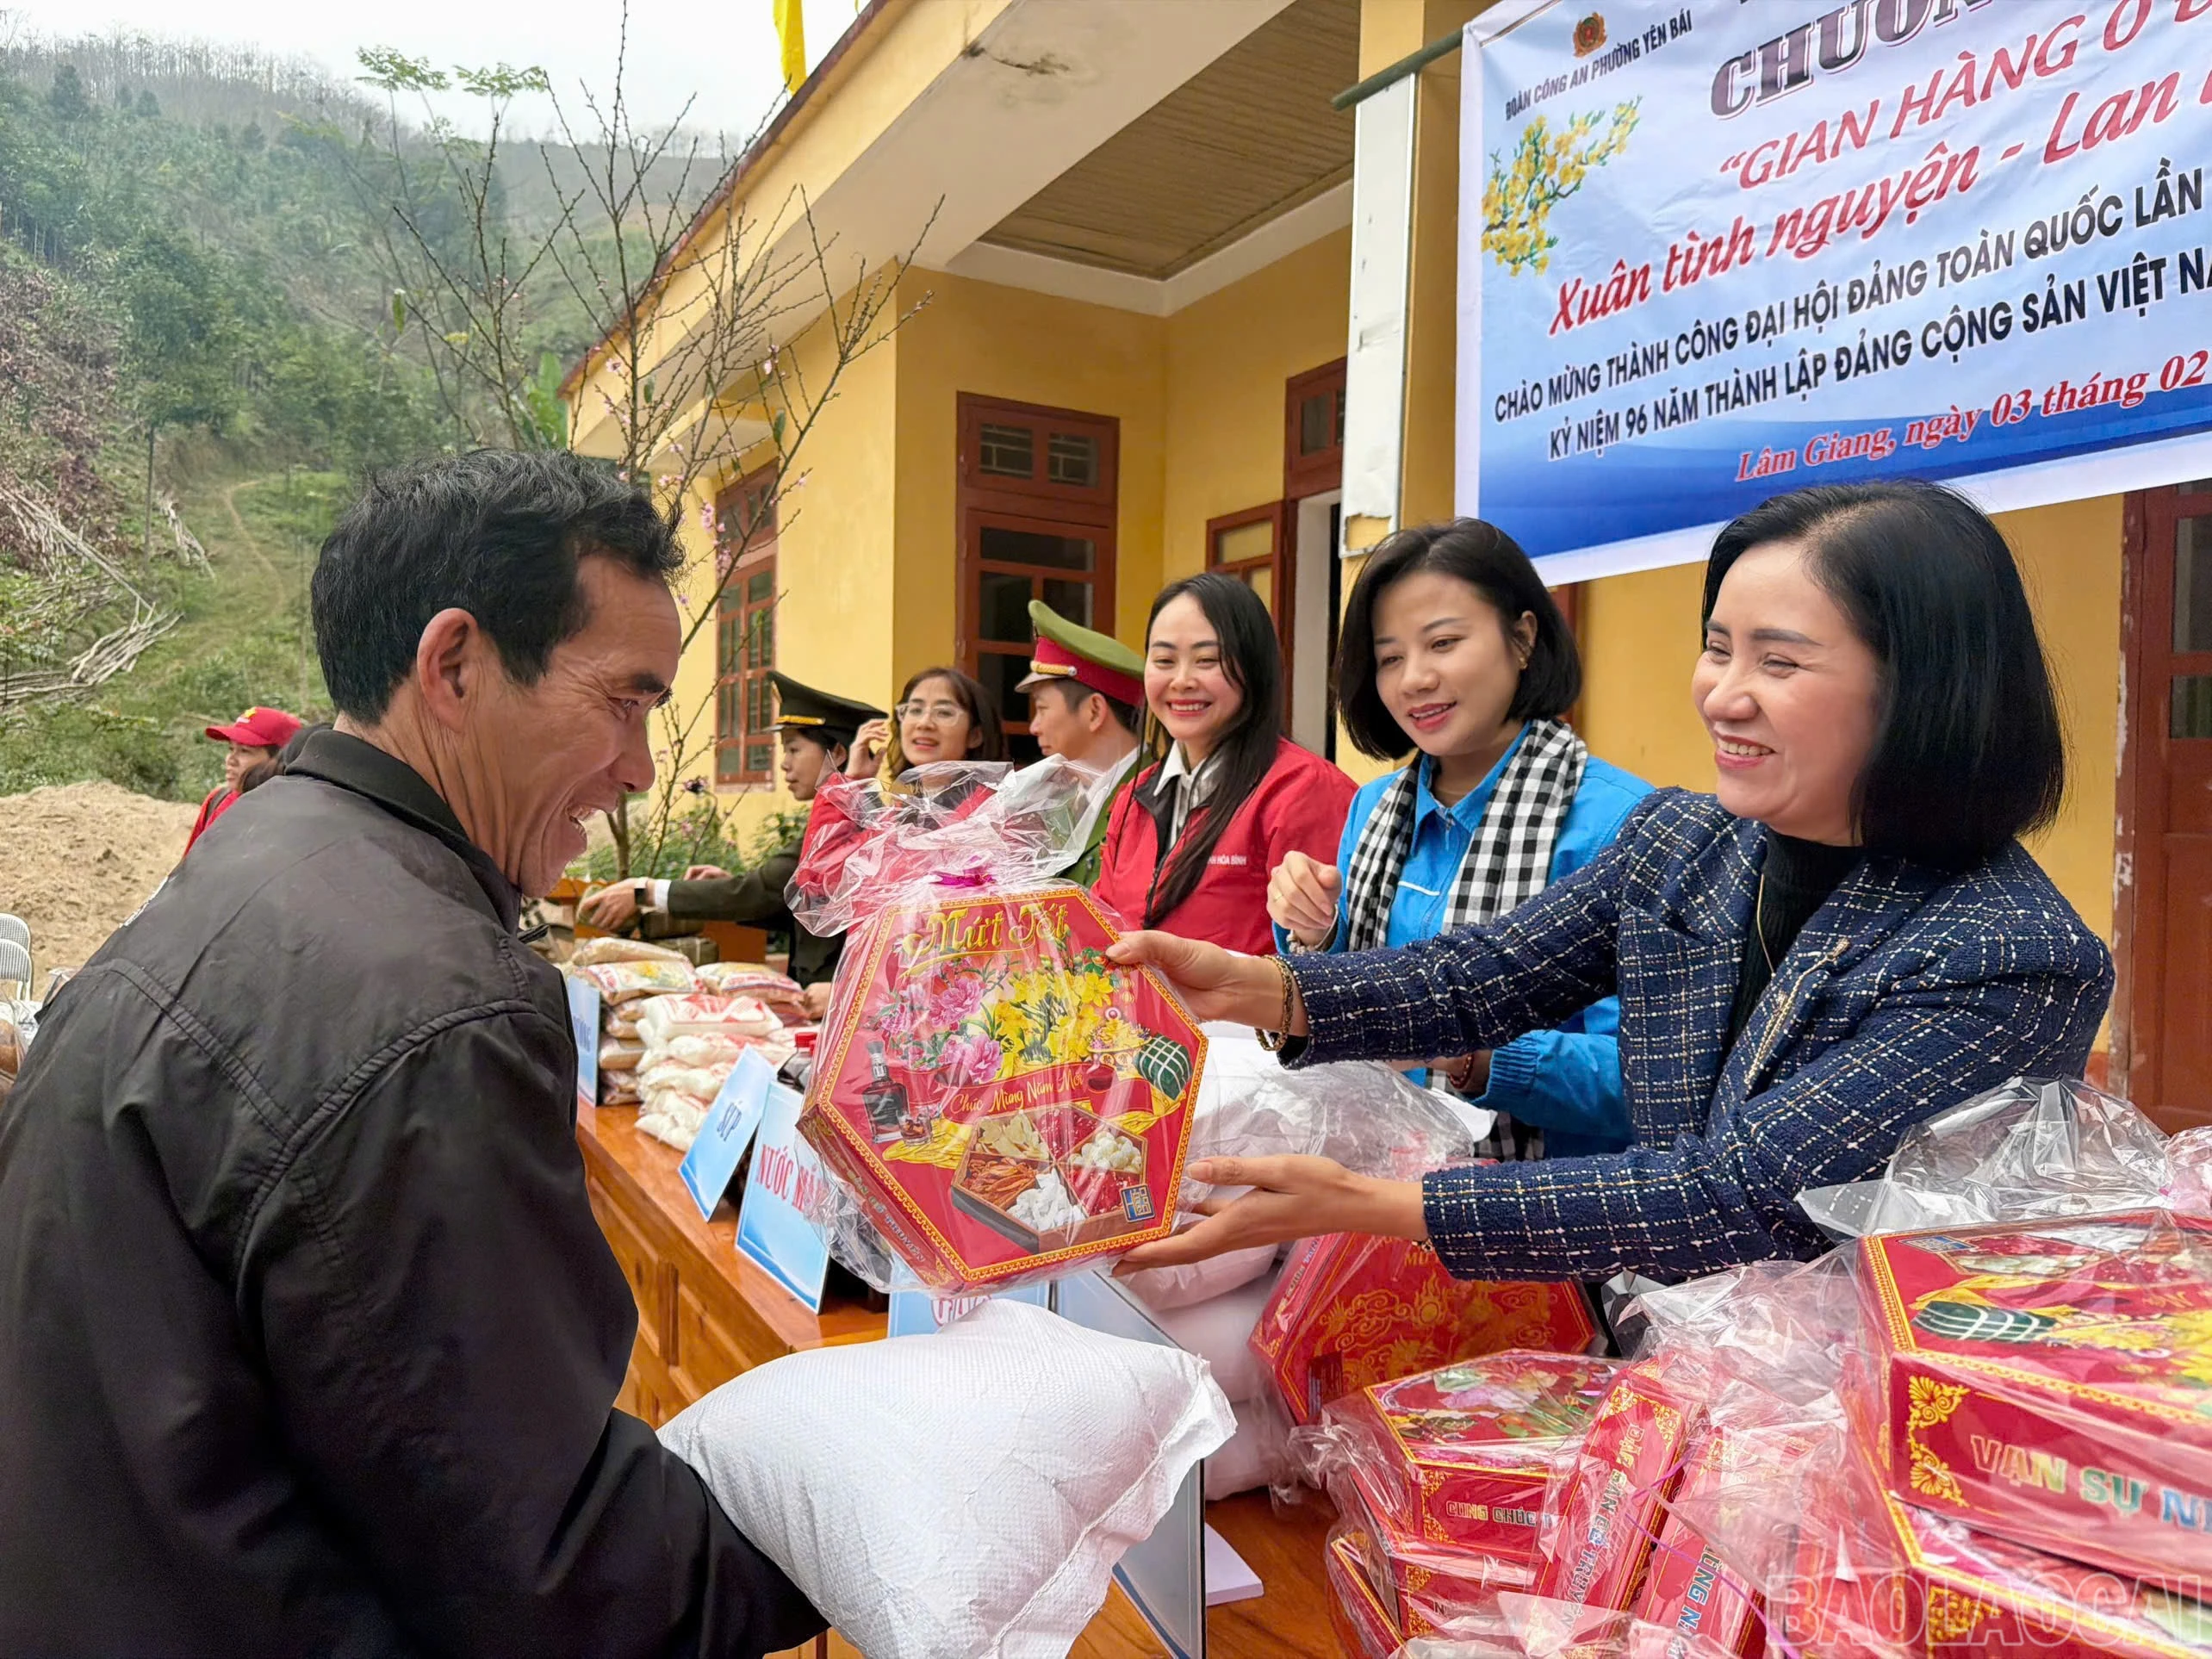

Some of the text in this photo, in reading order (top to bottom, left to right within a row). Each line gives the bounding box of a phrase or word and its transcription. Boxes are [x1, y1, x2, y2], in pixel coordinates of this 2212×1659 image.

[1506, 8, 1693, 121] ĐOÀN CÔNG AN PHƯỜNG YÊN BÁI
[1889, 15, 2086, 140] HÀNG
[1549, 259, 1651, 336] Xuân
[1662, 215, 1755, 293] tình
[1766, 141, 1979, 258] nguyện
[2043, 71, 2180, 164] Lan
[1495, 157, 2202, 422] CHÀO MỪNG THÀNH CÔNG ĐẠI HỘI ĐẢNG TOÀN QUỐC LẦN
[1550, 248, 2212, 459] KỶ NIỆM 96 NĂM THÀNH LẬP ĐẢNG CỘNG SẢN VIỆT N
[1737, 350, 2209, 482] Lâm Giang, ngày 03 tháng 02
[903, 908, 1003, 958] Mứt
[1027, 1081, 1053, 1103] Năm
[755, 1144, 793, 1201] NƯỚC
[1446, 1501, 1488, 1521] CUNG
[1493, 1507, 1537, 1526] CHÚC
[1970, 1433, 2067, 1494] VẠN
